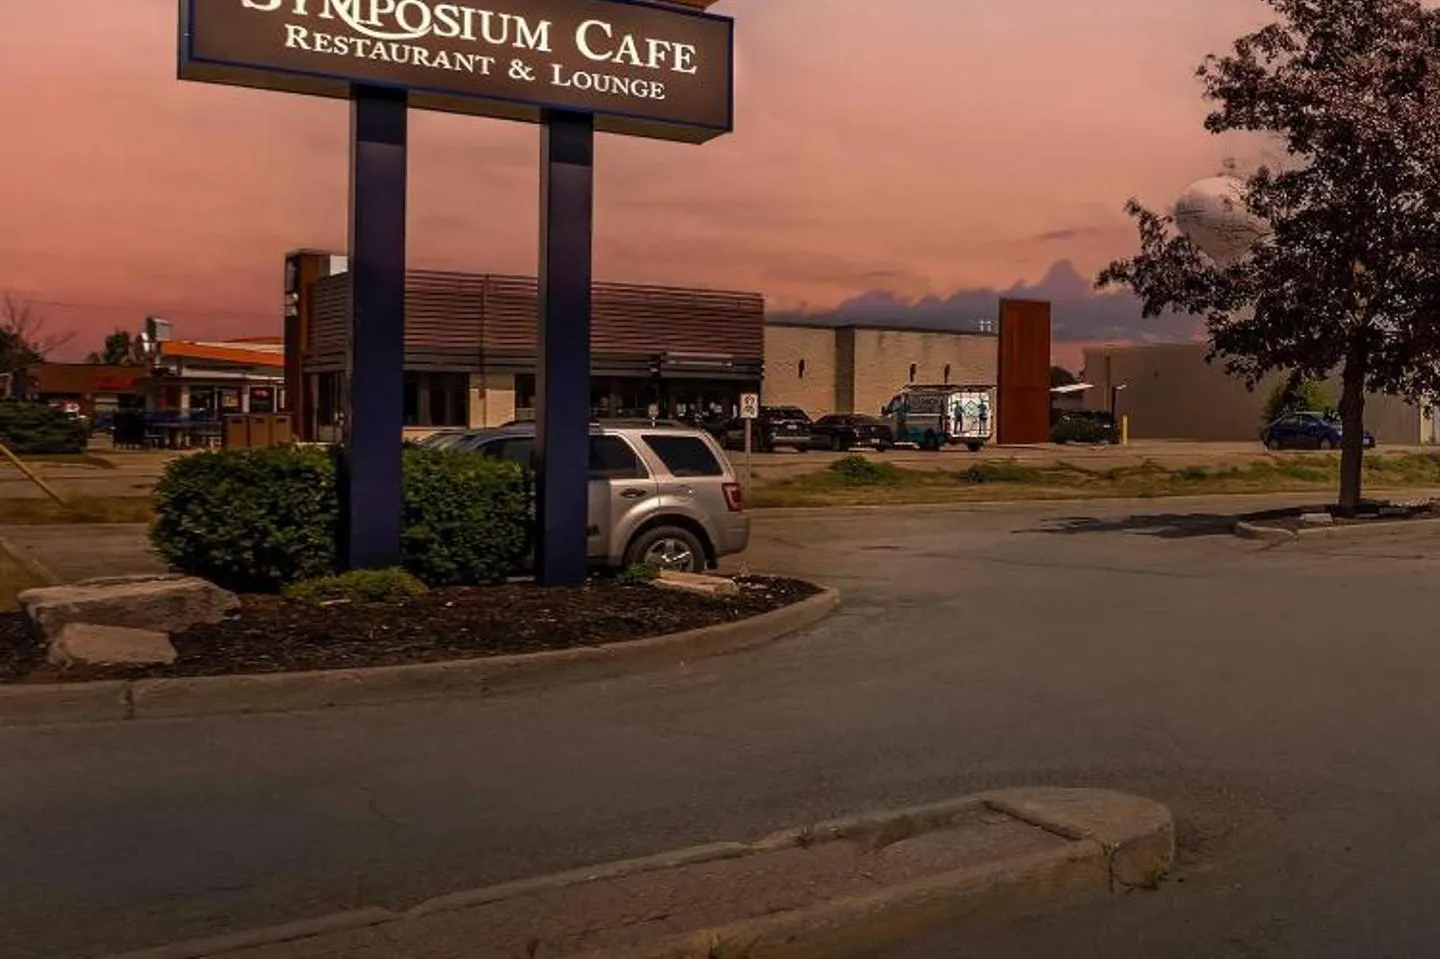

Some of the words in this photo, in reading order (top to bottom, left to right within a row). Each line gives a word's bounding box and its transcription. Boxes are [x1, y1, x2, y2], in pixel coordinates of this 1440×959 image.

[283, 23, 496, 75] RESTAURANT
[508, 58, 536, 82] &
[550, 63, 667, 101] LOUNGE
[575, 19, 698, 75] CAFE
